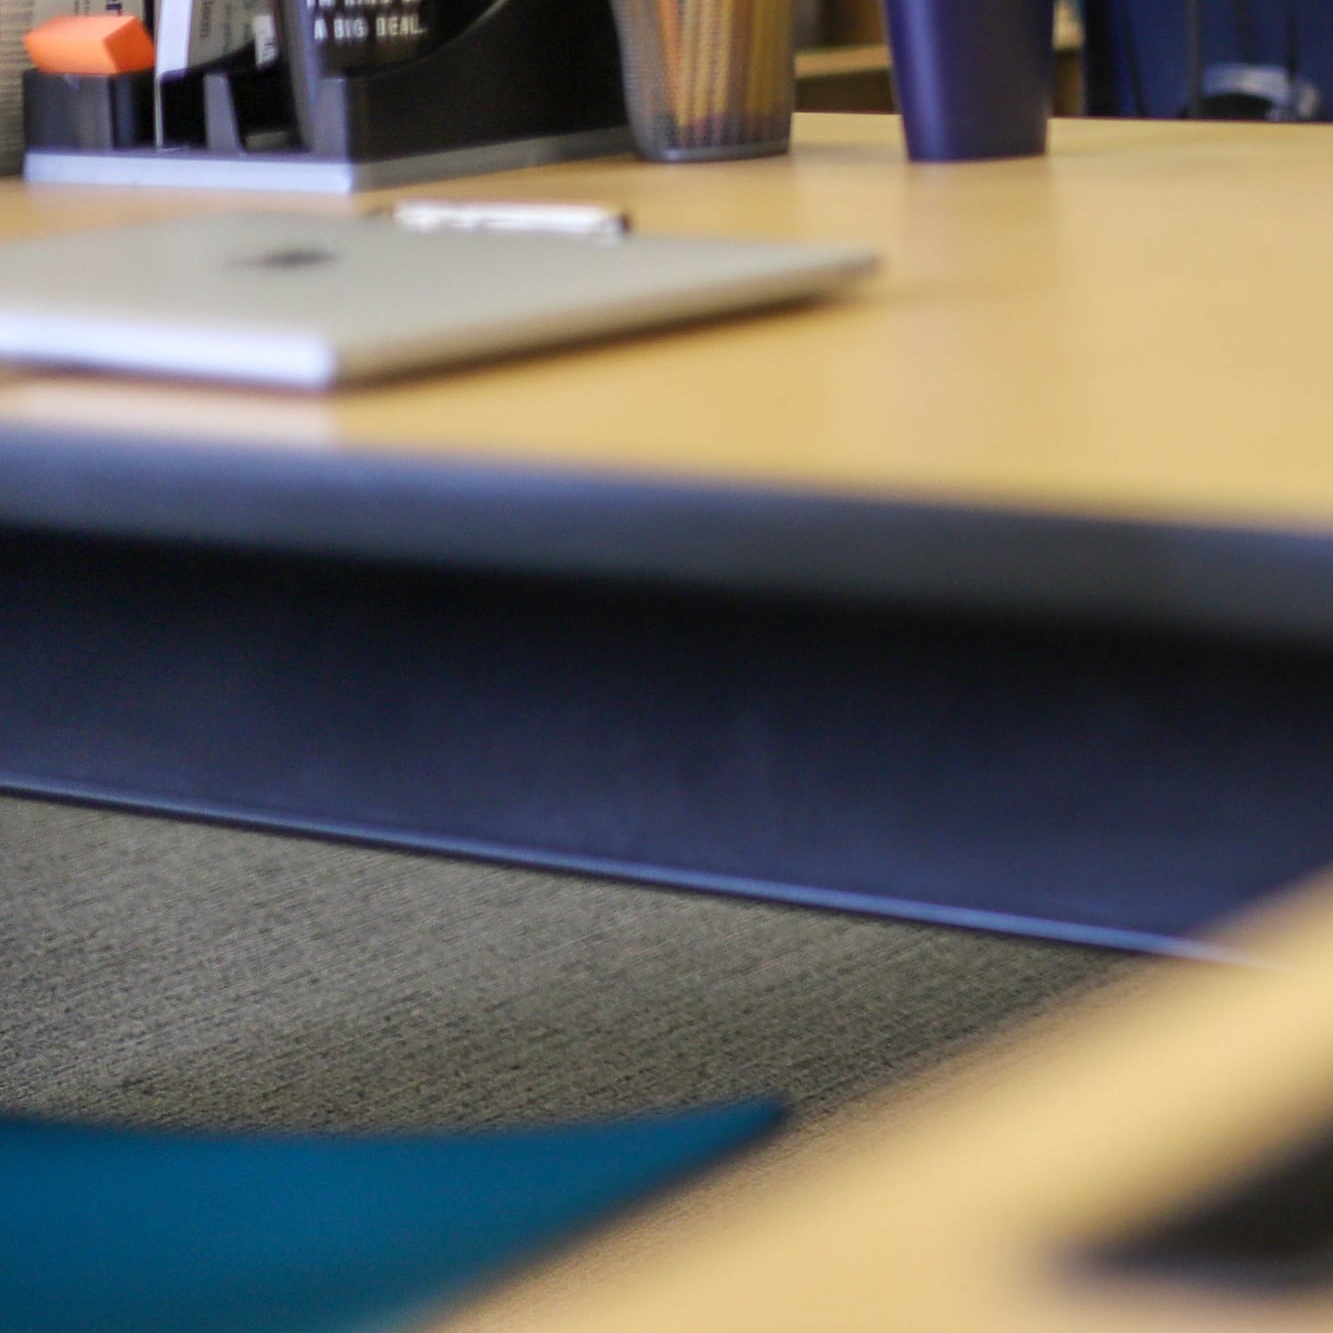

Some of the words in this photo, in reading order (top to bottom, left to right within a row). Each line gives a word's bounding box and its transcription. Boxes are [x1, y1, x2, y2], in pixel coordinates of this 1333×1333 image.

[314, 17, 327, 41] A
[333, 16, 368, 40] BIG
[375, 15, 428, 37] DEAL.
